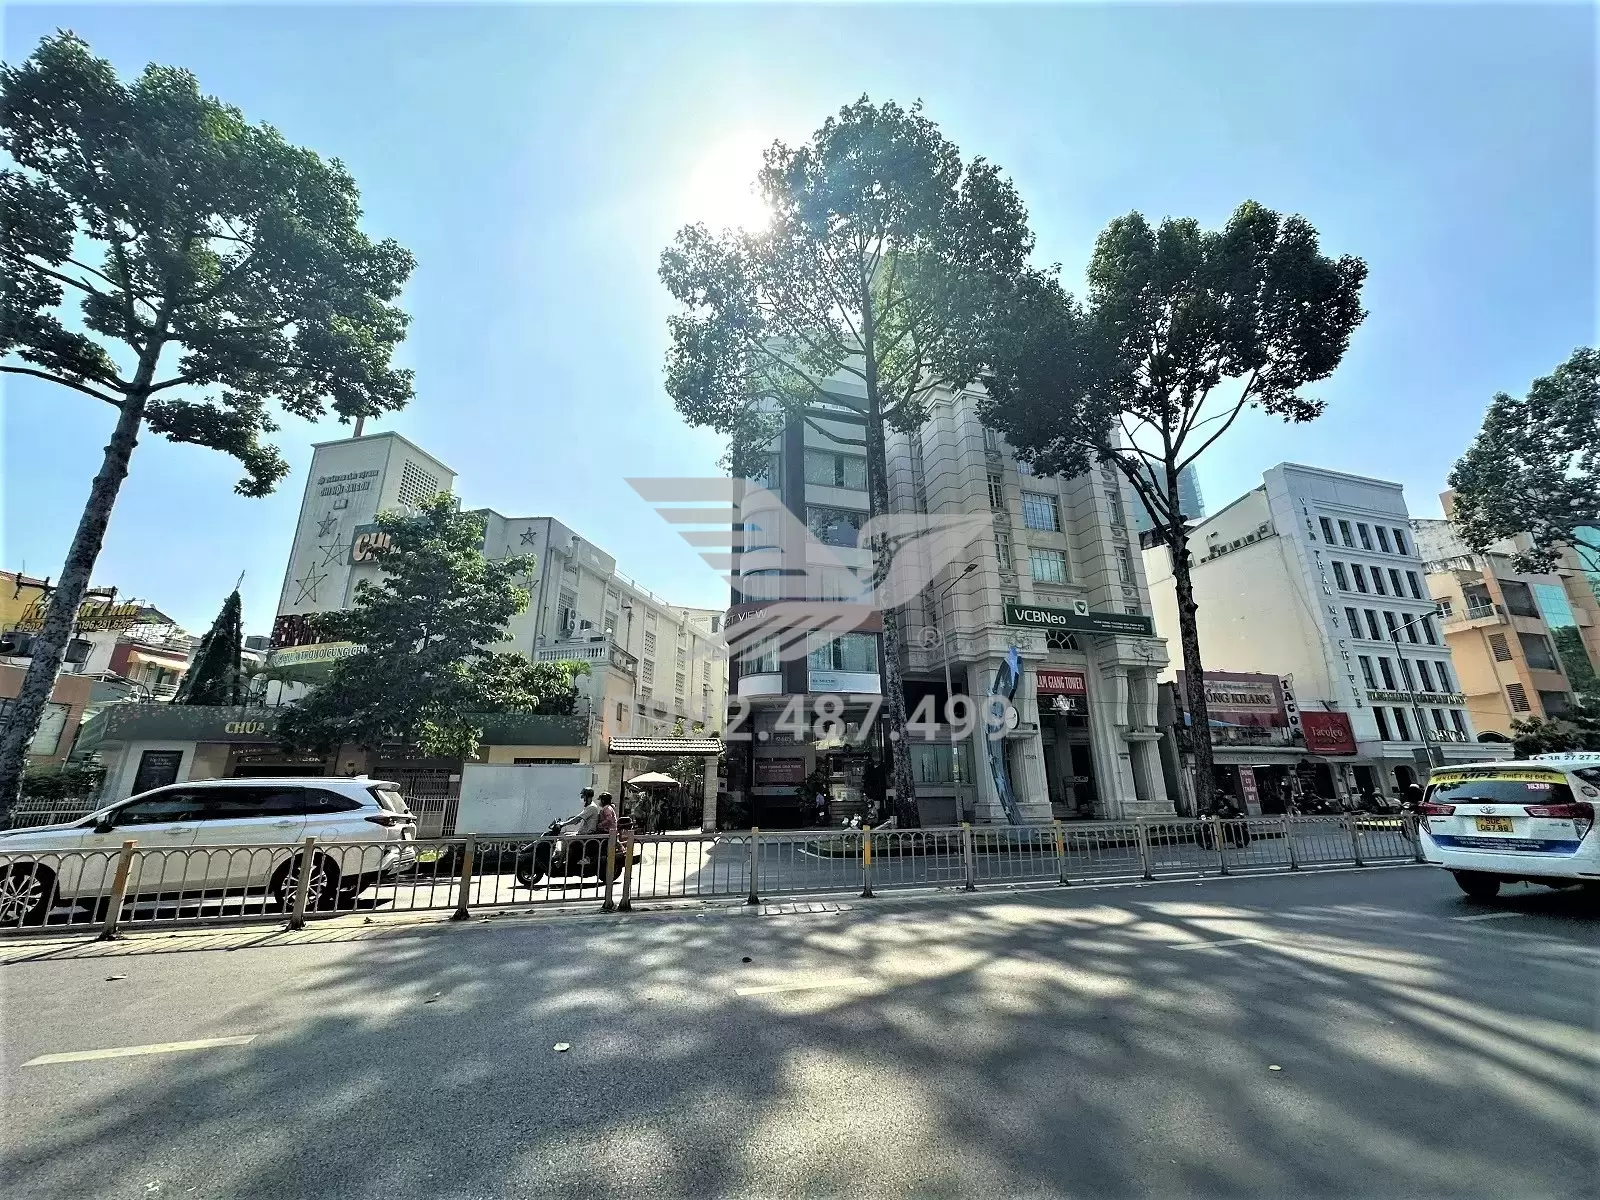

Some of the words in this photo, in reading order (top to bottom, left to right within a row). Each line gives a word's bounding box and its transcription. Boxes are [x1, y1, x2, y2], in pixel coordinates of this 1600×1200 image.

[737, 609, 768, 622] VIEW
[1014, 608, 1067, 625] VCBNeo
[1048, 675, 1065, 689] GIANG
[1065, 676, 1084, 690] TOWER
[1230, 693, 1271, 705] KHANG
[1281, 679, 1304, 739] TACOS
[1460, 771, 1497, 780] MPE
